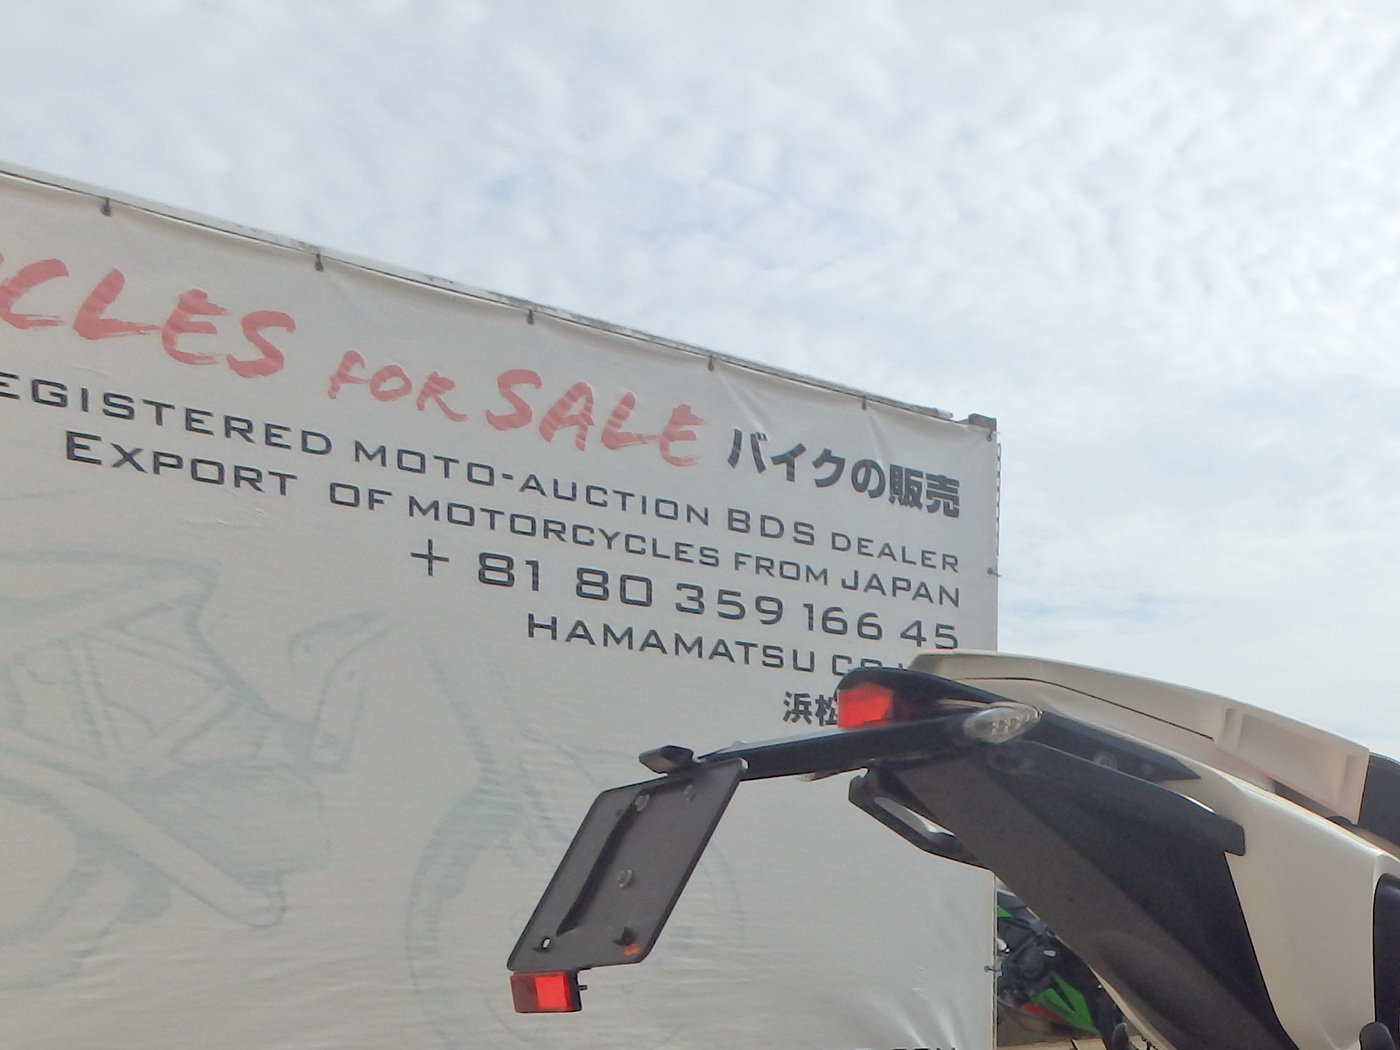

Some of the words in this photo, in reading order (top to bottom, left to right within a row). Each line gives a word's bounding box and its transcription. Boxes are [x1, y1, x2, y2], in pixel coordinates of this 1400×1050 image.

[0, 252, 296, 379] CLES
[327, 350, 468, 423] FOR
[485, 369, 706, 466] SALE
[65, 430, 298, 496] EXPORT
[329, 482, 393, 511] OF
[408, 495, 720, 568] MOTORCYCLES
[734, 552, 828, 586] FROM
[841, 569, 960, 608] JAPAN
[354, 440, 710, 526] MOTO-AUCTION
[727, 507, 815, 546] BDS
[831, 531, 959, 573] DEALER
[727, 428, 960, 519] バイクの販売
[410, 538, 450, 577] +
[477, 552, 540, 592] 81
[575, 567, 653, 608] 80
[675, 582, 784, 626] 359
[802, 603, 883, 641] 166
[900, 620, 959, 650] 45
[527, 613, 815, 673] HAMAMATSU
